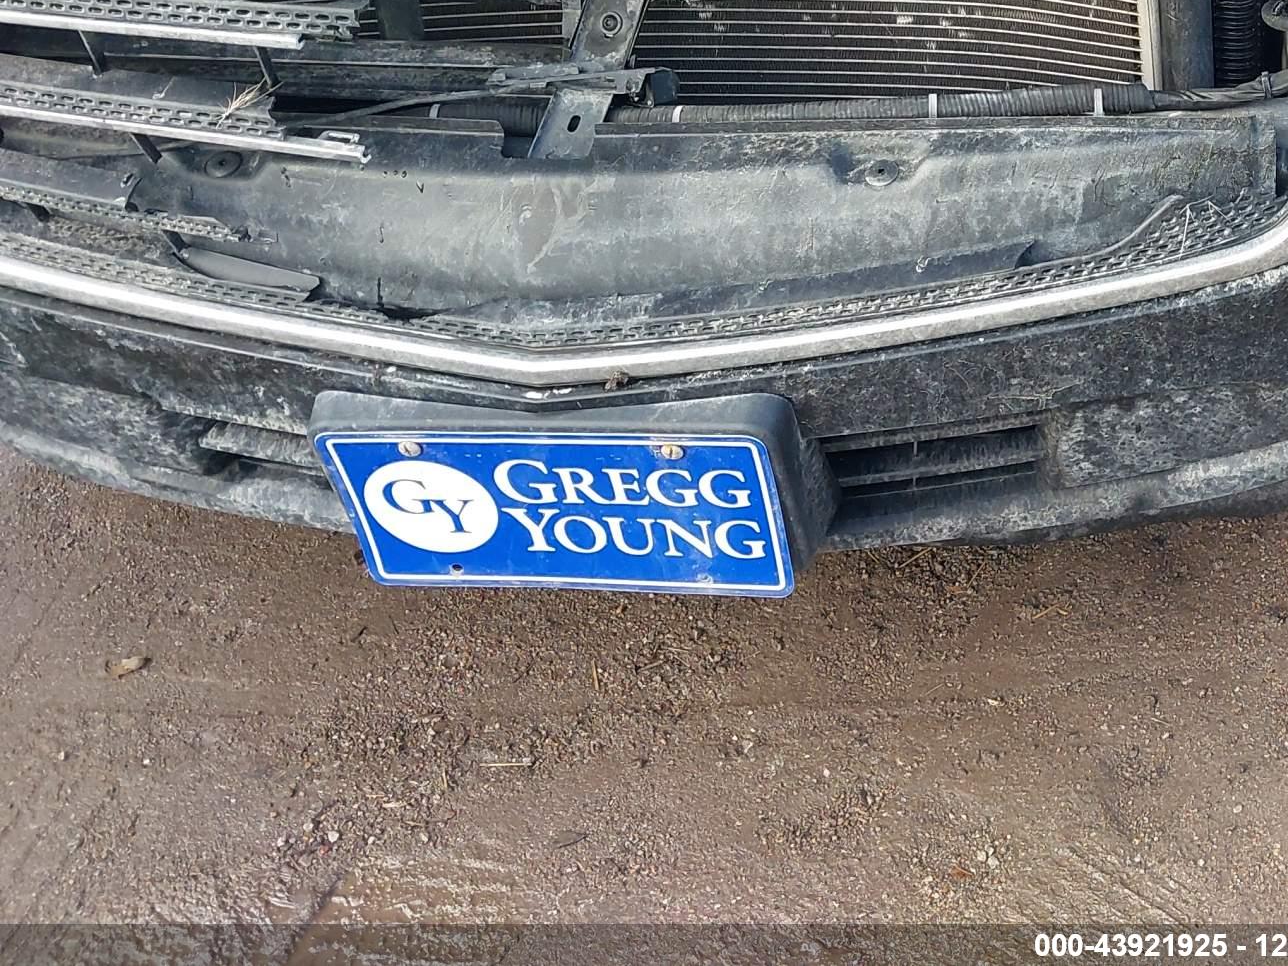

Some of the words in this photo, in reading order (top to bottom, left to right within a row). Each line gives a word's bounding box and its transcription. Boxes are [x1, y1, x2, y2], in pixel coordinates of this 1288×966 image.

[382, 479, 475, 533] GY
[493, 458, 752, 508] GREGG
[501, 507, 767, 559] YOUNG
